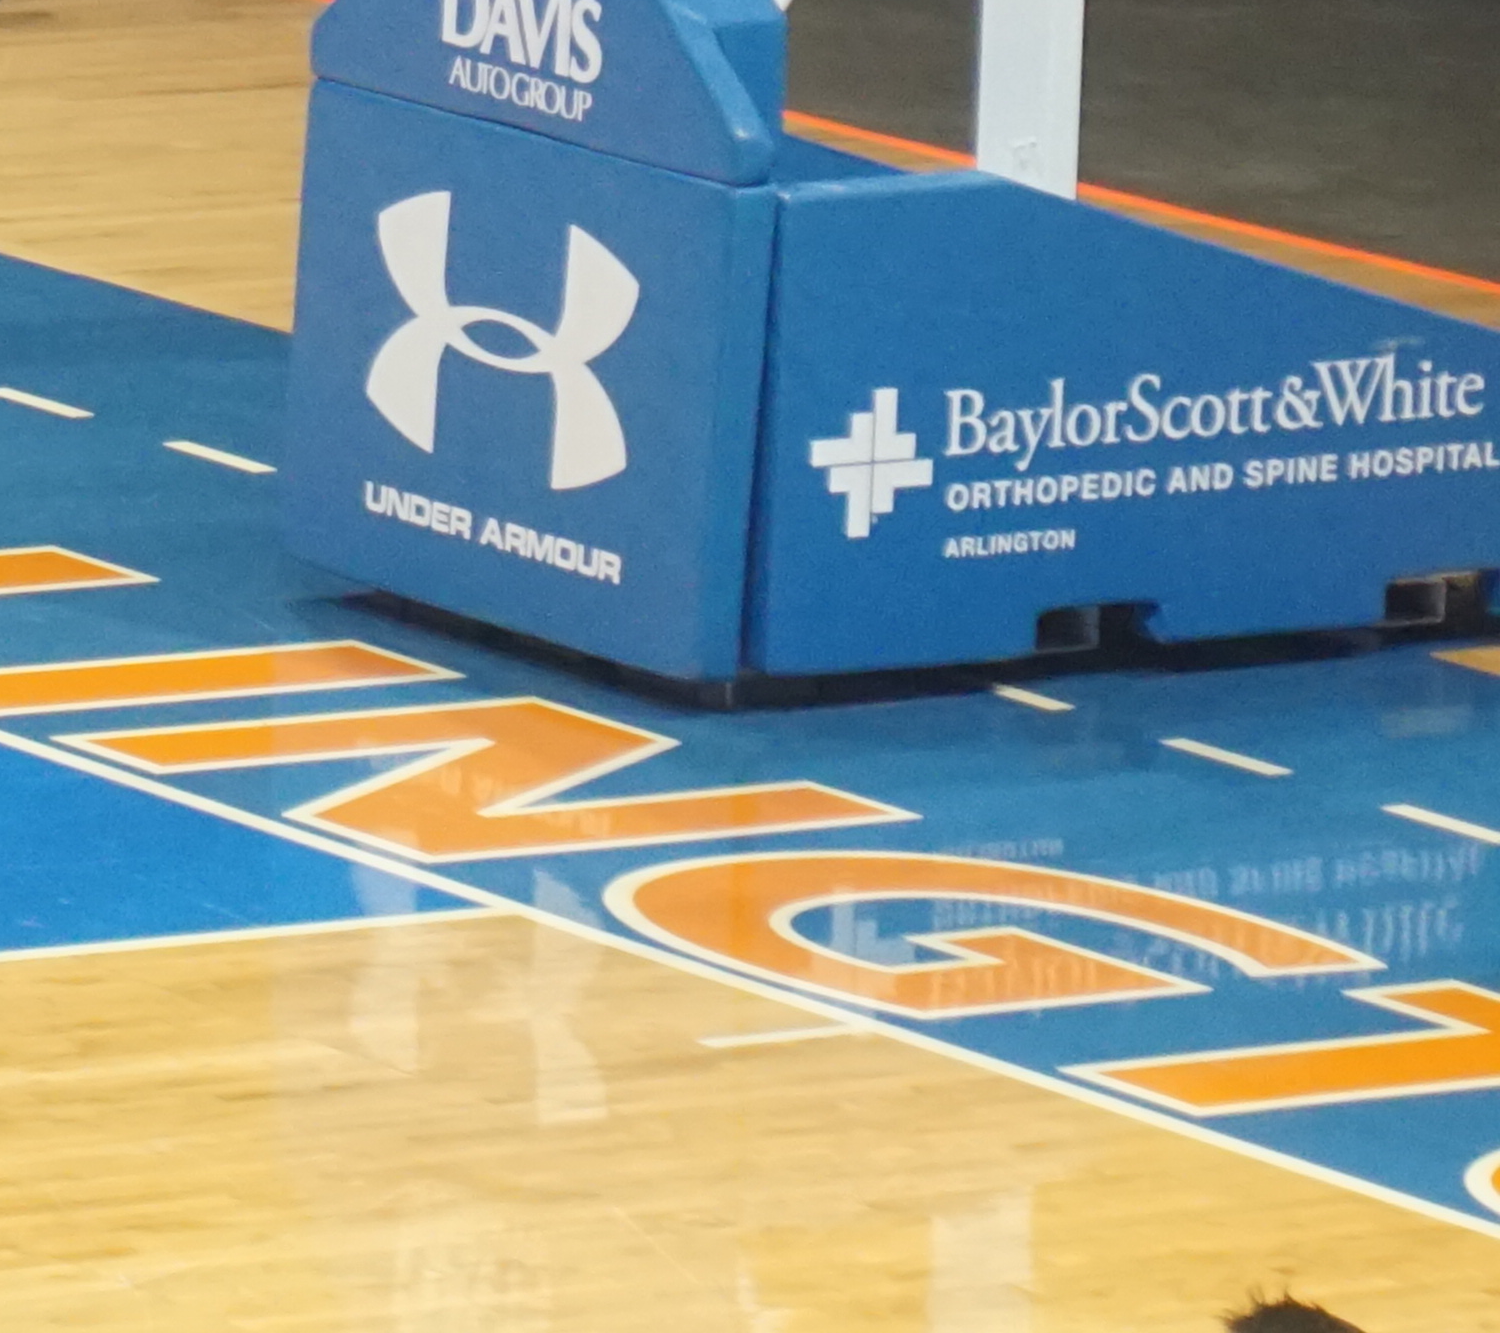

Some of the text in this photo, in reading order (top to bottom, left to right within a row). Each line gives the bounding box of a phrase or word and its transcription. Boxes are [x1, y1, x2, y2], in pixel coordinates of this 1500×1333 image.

[946, 443, 1500, 512] ORTHOPEDIC AND SPINE HOSPITAL
[364, 480, 622, 587] UNDER ARMOUR
[942, 528, 1077, 560] ARLINGTON
